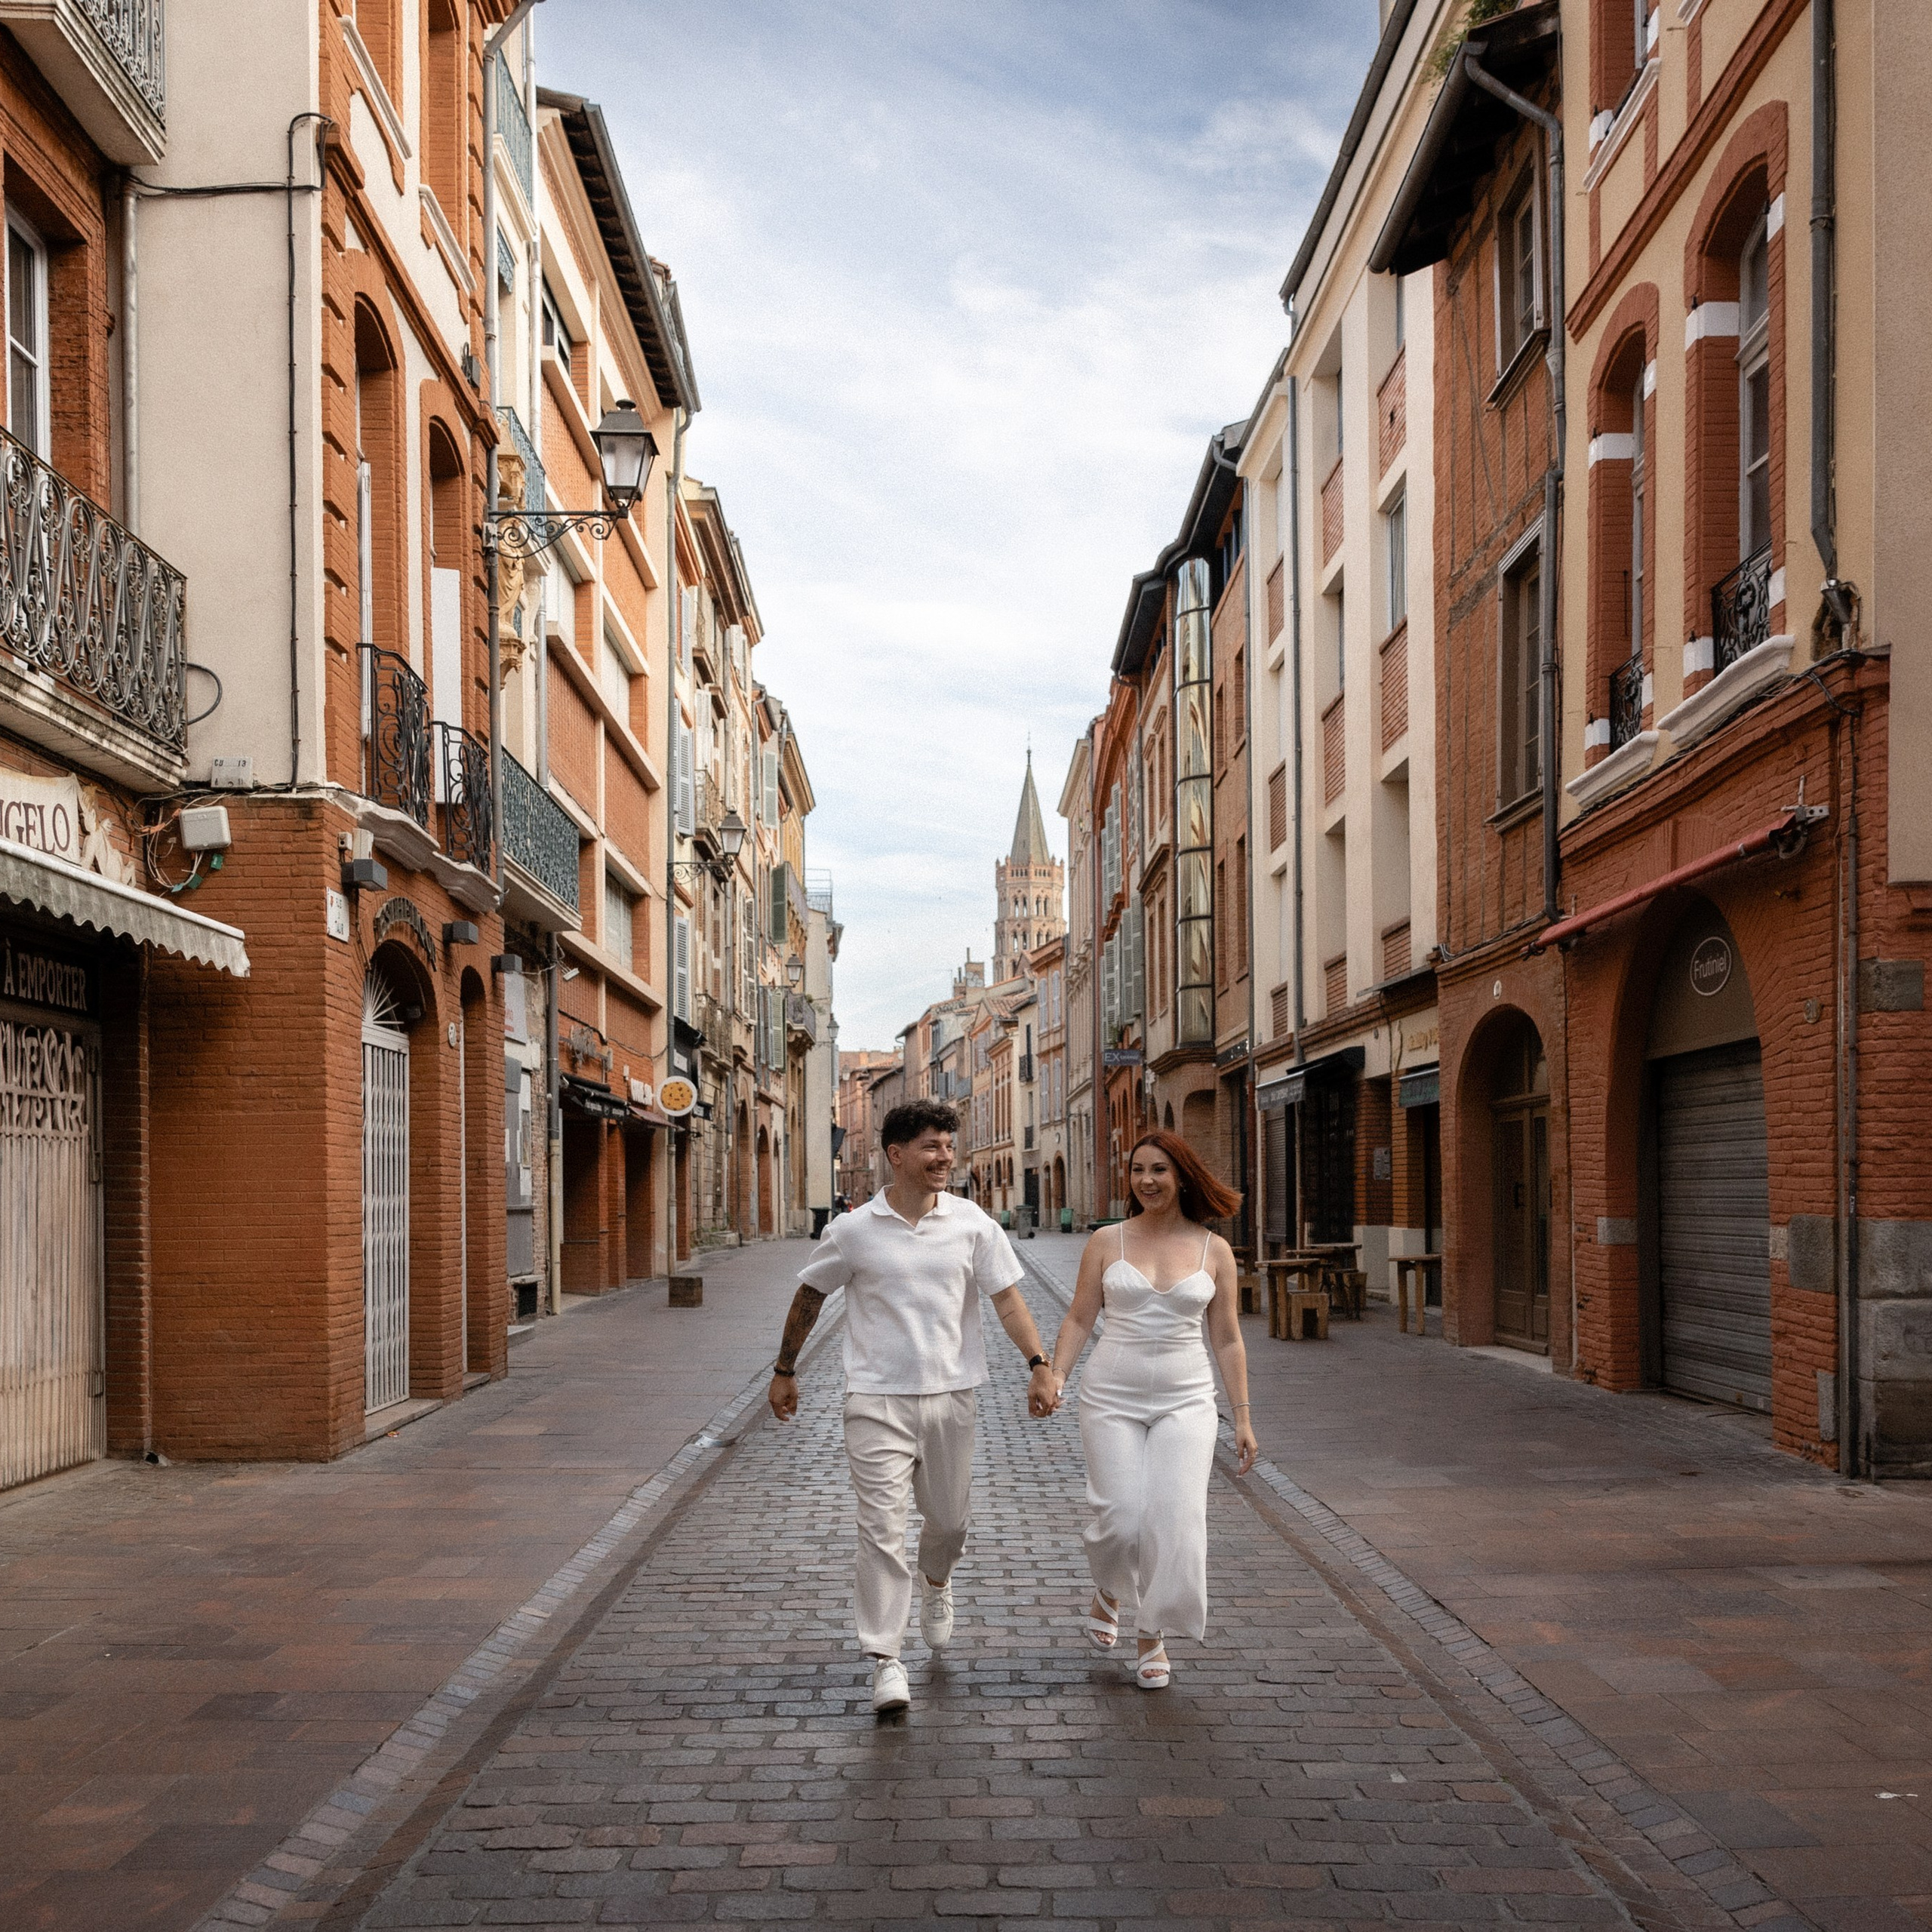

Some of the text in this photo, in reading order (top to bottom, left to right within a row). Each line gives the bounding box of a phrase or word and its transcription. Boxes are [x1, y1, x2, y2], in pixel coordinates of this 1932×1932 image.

[5, 937, 88, 1011] À EMPORTER
[1694, 950, 1727, 980] Frutiniel
